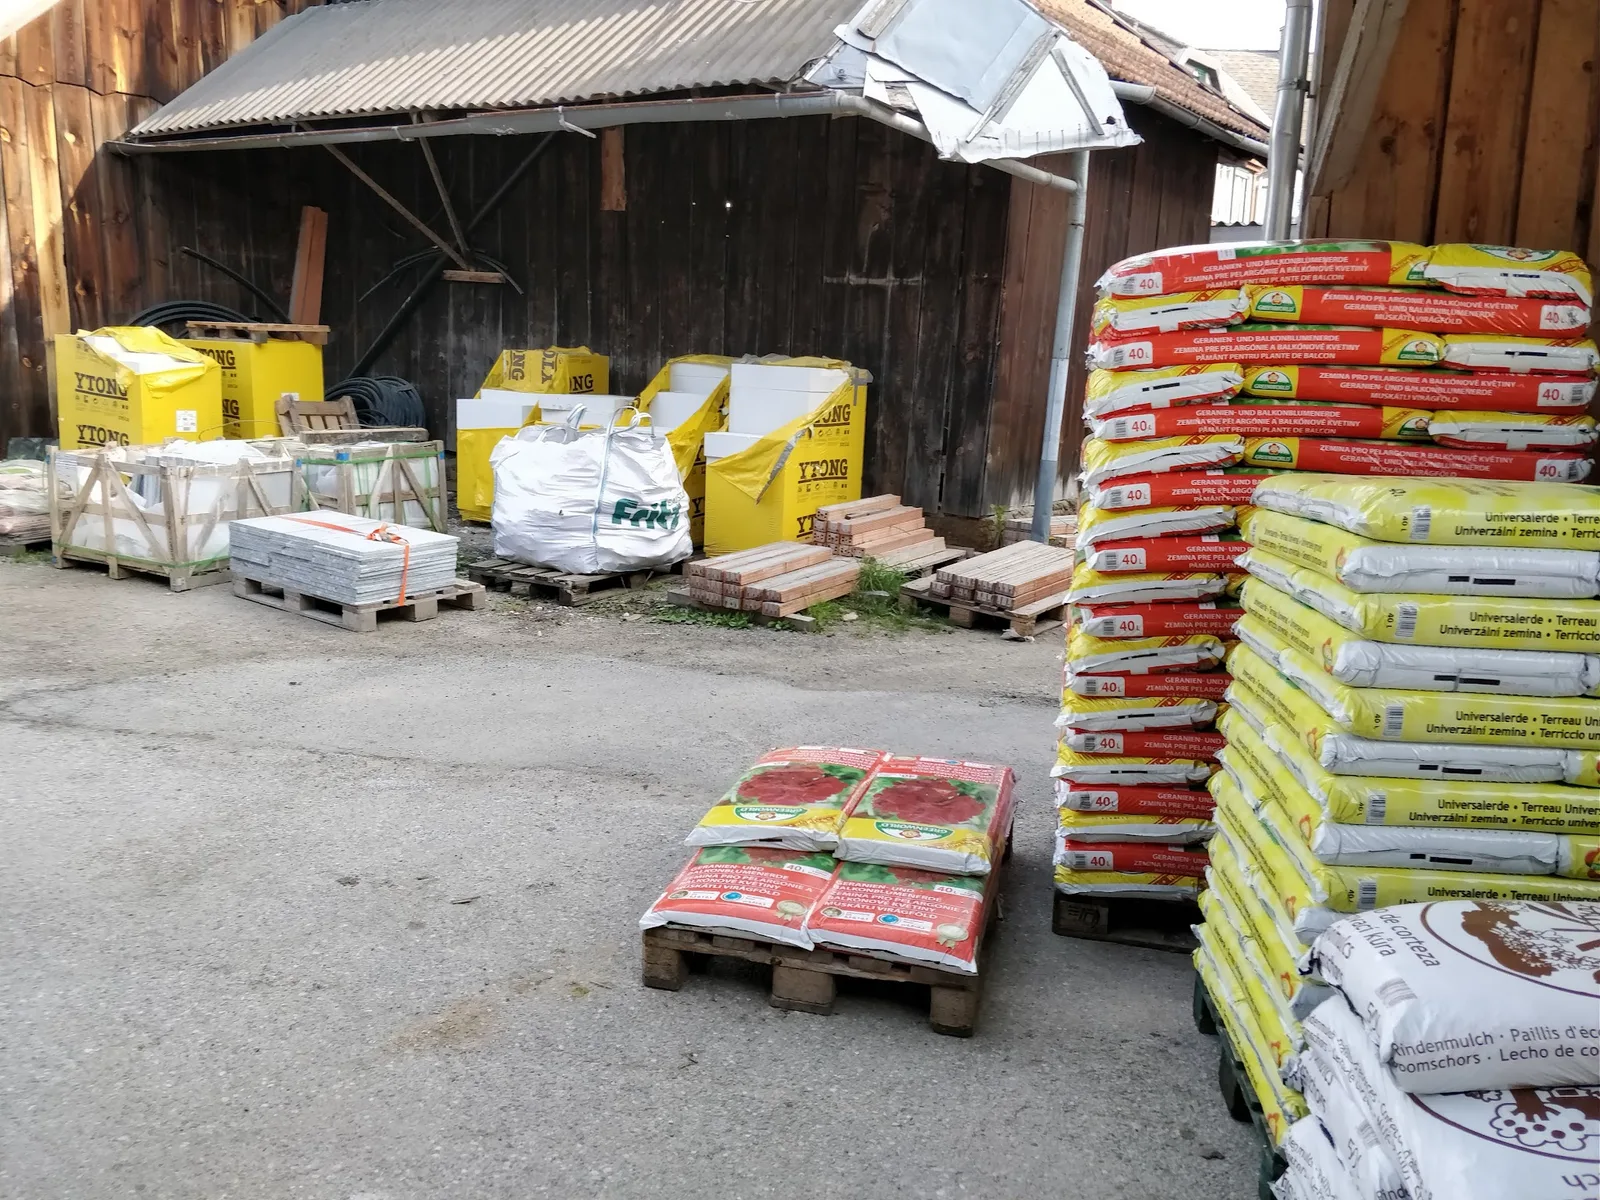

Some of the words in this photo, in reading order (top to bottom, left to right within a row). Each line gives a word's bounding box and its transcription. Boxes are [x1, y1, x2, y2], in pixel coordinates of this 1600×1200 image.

[1203, 263, 1245, 273] GERANIEN-
[1264, 256, 1348, 266] BALKONBLUMENERDE
[1140, 279, 1154, 289] 40
[1184, 275, 1214, 283] ZEMINA
[1270, 275, 1299, 283] PLANTE
[1324, 293, 1354, 301] ZEMINA
[1255, 334, 1340, 342] BALKONBLUMENERDE
[1129, 348, 1144, 359] 40
[1340, 382, 1382, 390] GERANIEN-
[1543, 389, 1559, 400] 40
[1131, 420, 1147, 432] 40
[1176, 418, 1205, 426] ZEMINA
[77, 424, 130, 447] YTONG
[1320, 445, 1350, 453] ZEMINA
[799, 459, 848, 480] YTONG
[1539, 466, 1557, 477] 40
[1127, 490, 1142, 501] 40
[1171, 488, 1201, 496] ZEMINA
[1485, 512, 1560, 523] Universalerde
[1455, 526, 1517, 536] Univerzální
[1519, 528, 1558, 538] zemina
[1122, 554, 1137, 565] 40
[1167, 554, 1196, 562] ZEMINA
[1470, 612, 1544, 624] Universalerde
[1556, 615, 1597, 626] Terreau
[1119, 620, 1134, 631] 40
[1440, 625, 1500, 637] Univerzální
[1503, 628, 1542, 639] zemina
[1165, 676, 1204, 684] GERANIEN-
[1102, 682, 1117, 692] 40
[1456, 711, 1529, 724] Universalerde
[1541, 714, 1581, 726] Terreau
[1426, 724, 1486, 735] Univerzální
[1489, 727, 1527, 737] zemina
[1540, 728, 1586, 740] Terriccio
[1100, 738, 1115, 749] 40
[1163, 734, 1203, 742] GERANIEN-
[1144, 741, 1173, 749] ZEMINA
[1096, 796, 1111, 807] 40
[1438, 799, 1510, 811] Universalerde
[1522, 802, 1562, 814] Terreau
[1409, 812, 1468, 823] Univerzální
[1471, 814, 1508, 824] zemina
[1521, 816, 1565, 827] Terriccio
[881, 822, 948, 835] GREENWORLD
[1090, 856, 1106, 867] 40
[742, 875, 805, 890] PELARGONIE
[871, 894, 893, 902] PRO
[1428, 886, 1499, 899] Universalerde
[1510, 890, 1550, 901] Terreau
[1380, 913, 1401, 924] de
[1391, 925, 1441, 967] corteza
[1391, 1031, 1494, 1057] Rindenmulch
[1510, 1026, 1560, 1043] Paillis
[1500, 1045, 1549, 1062] Lecho
[1555, 1044, 1575, 1058] de
